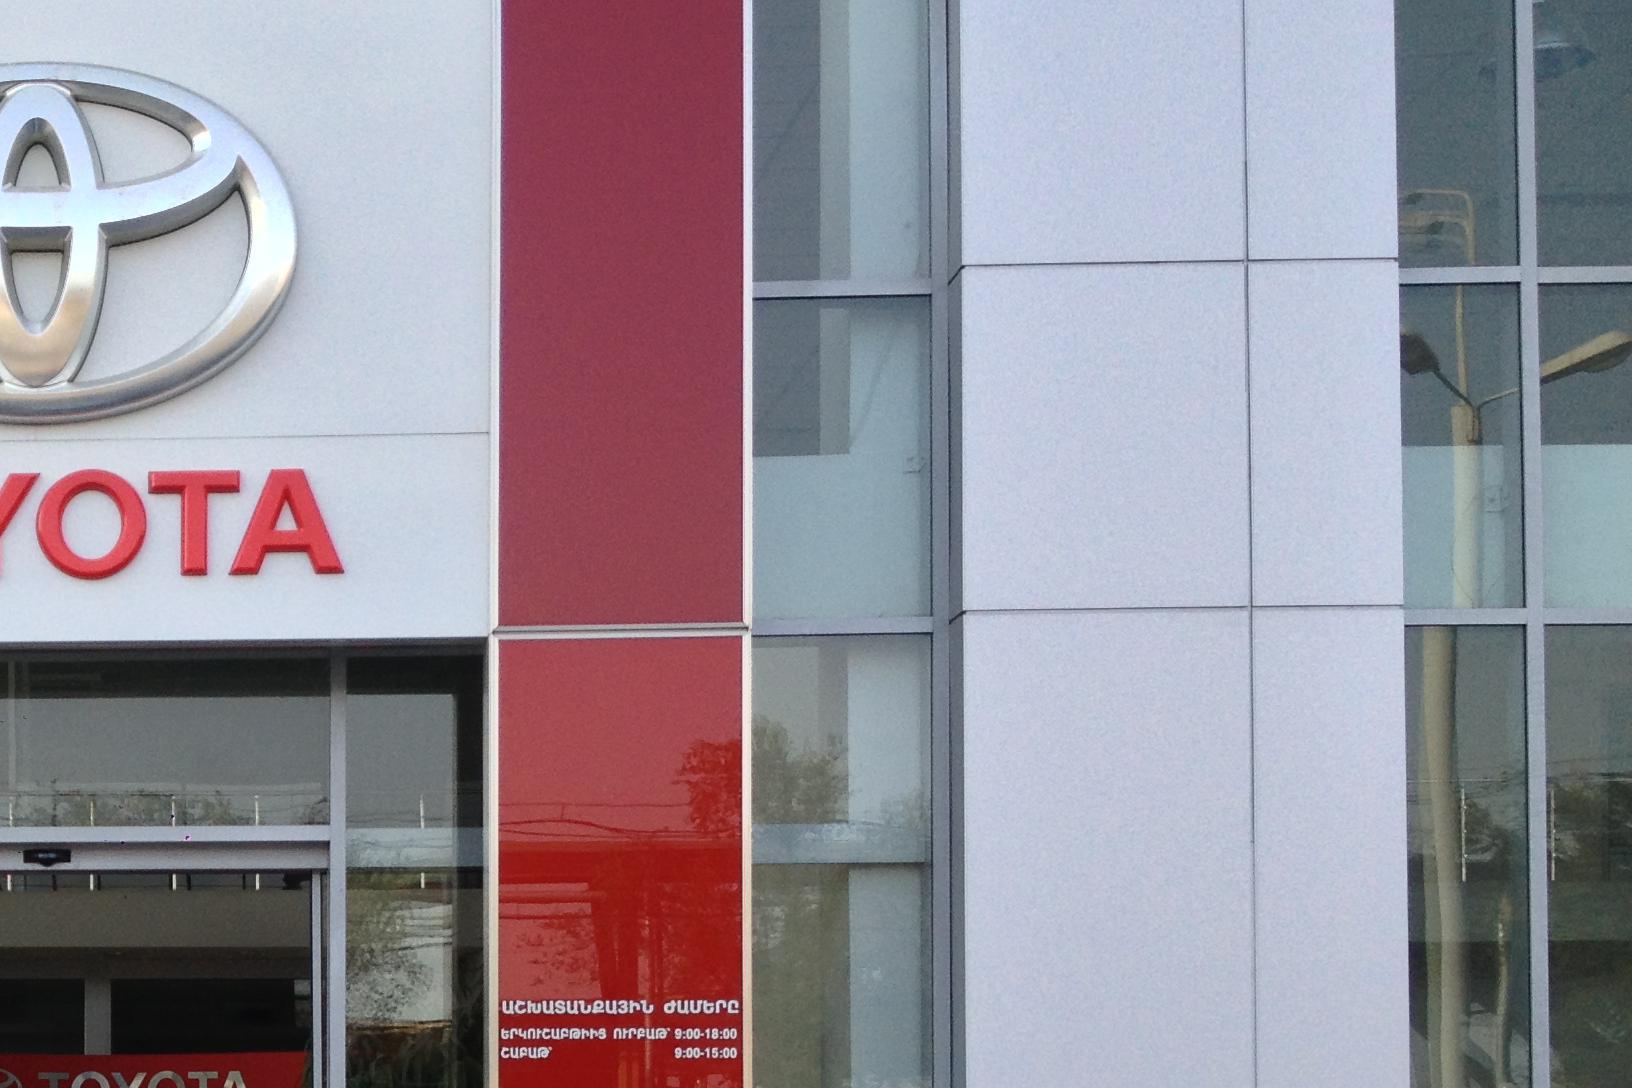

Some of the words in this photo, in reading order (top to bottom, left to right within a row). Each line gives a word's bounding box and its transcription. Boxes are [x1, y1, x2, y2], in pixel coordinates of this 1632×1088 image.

[501, 999, 655, 1015] ԱՇԽԱՏԱՆՔԱՅԻՆ
[663, 999, 740, 1015] ԺԱՄԵՐԸ
[674, 1028, 738, 1040] 9:00-18:00
[674, 1047, 738, 1059] 9:00-15:00
